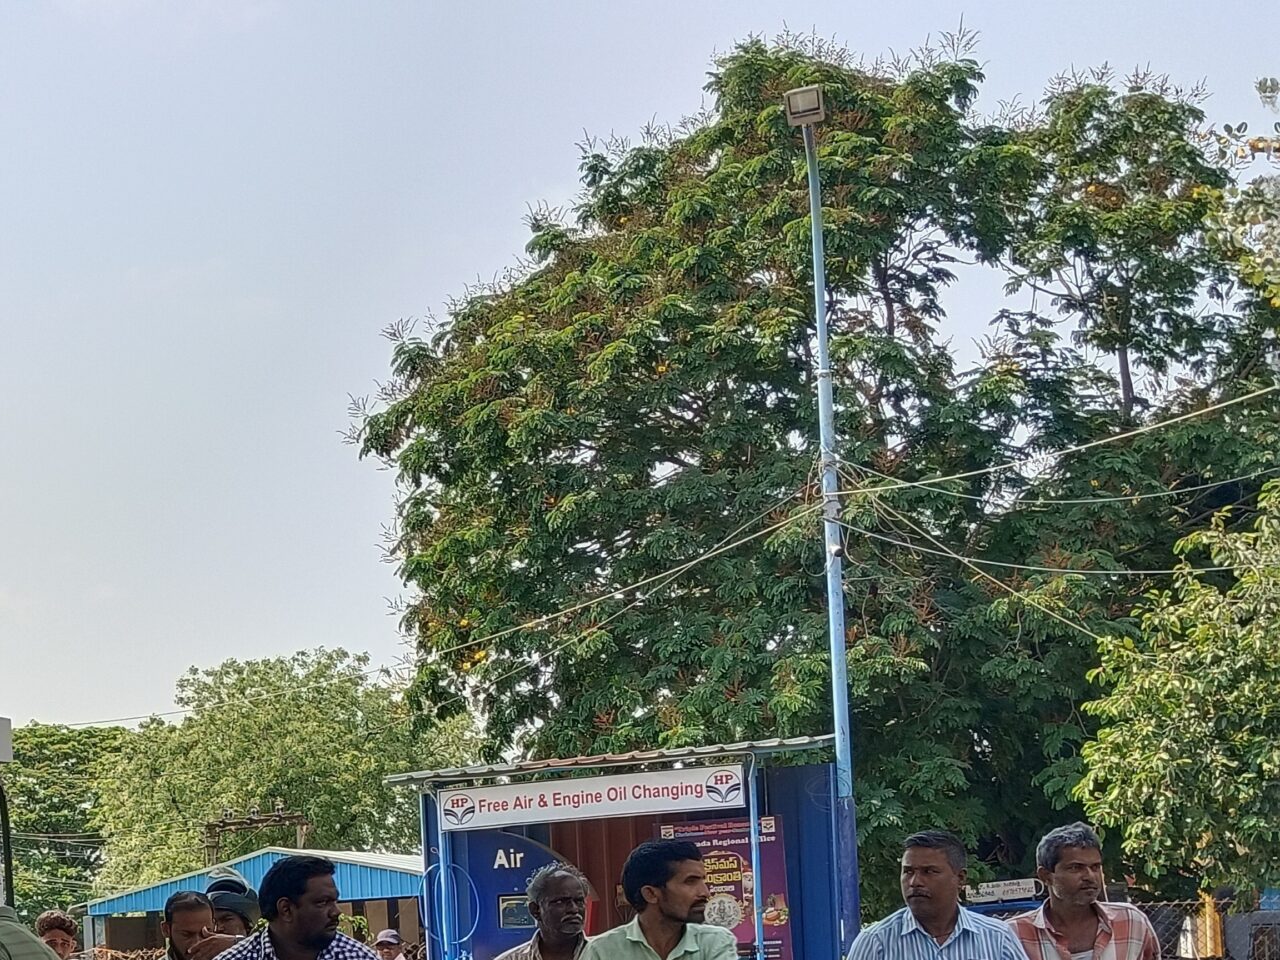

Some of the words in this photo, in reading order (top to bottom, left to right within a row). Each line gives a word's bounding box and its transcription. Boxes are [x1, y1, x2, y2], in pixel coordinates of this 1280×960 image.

[451, 797, 468, 809] HP
[478, 799, 509, 813] Free
[513, 795, 533, 810] Air
[537, 793, 548, 808] &
[553, 790, 602, 808] Engine
[607, 786, 627, 802] Oil
[632, 782, 704, 800] Changing
[714, 774, 734, 786] HP
[712, 837, 749, 846] Regional
[493, 849, 524, 869] Air
